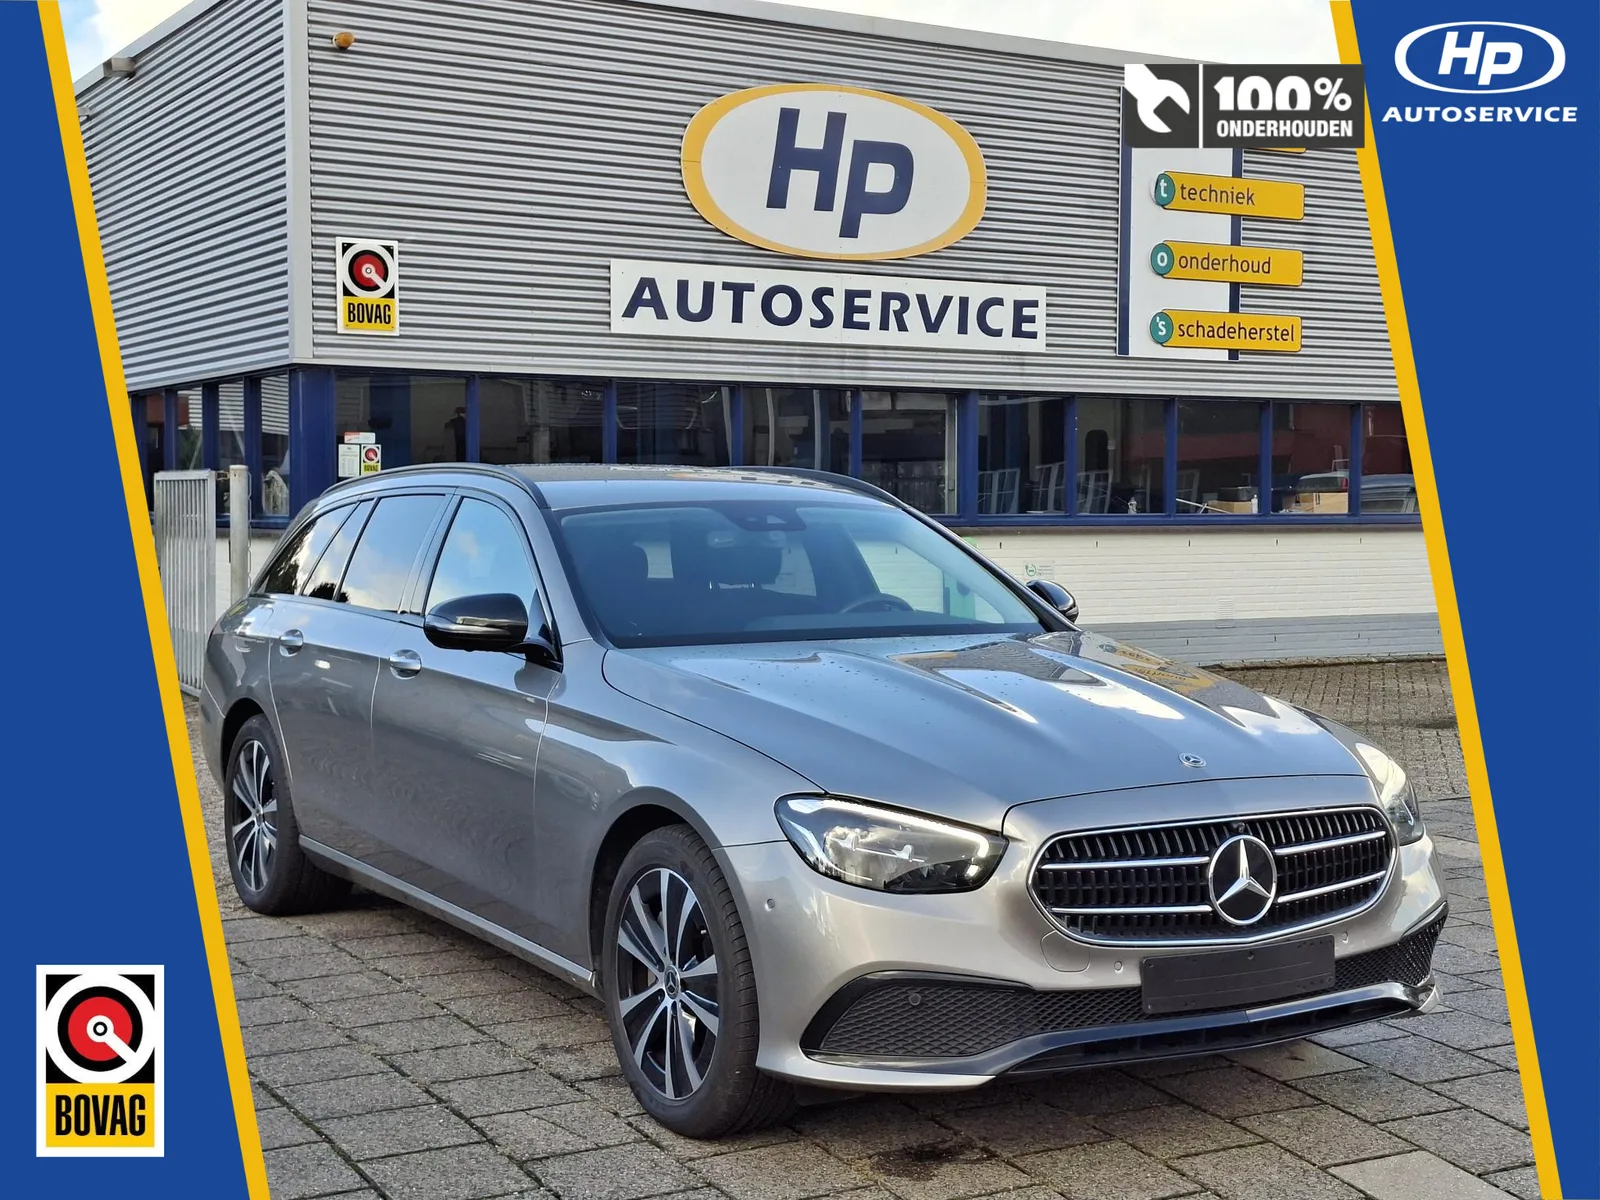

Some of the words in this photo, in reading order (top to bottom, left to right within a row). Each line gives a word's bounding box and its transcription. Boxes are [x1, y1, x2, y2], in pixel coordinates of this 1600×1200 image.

[1180, 184, 1255, 206] techniek
[1178, 252, 1271, 274] onderhoud
[347, 302, 391, 325] BOVAG
[622, 276, 1039, 339] AUTOSERVICE
[1178, 321, 1295, 342] schadeherstel
